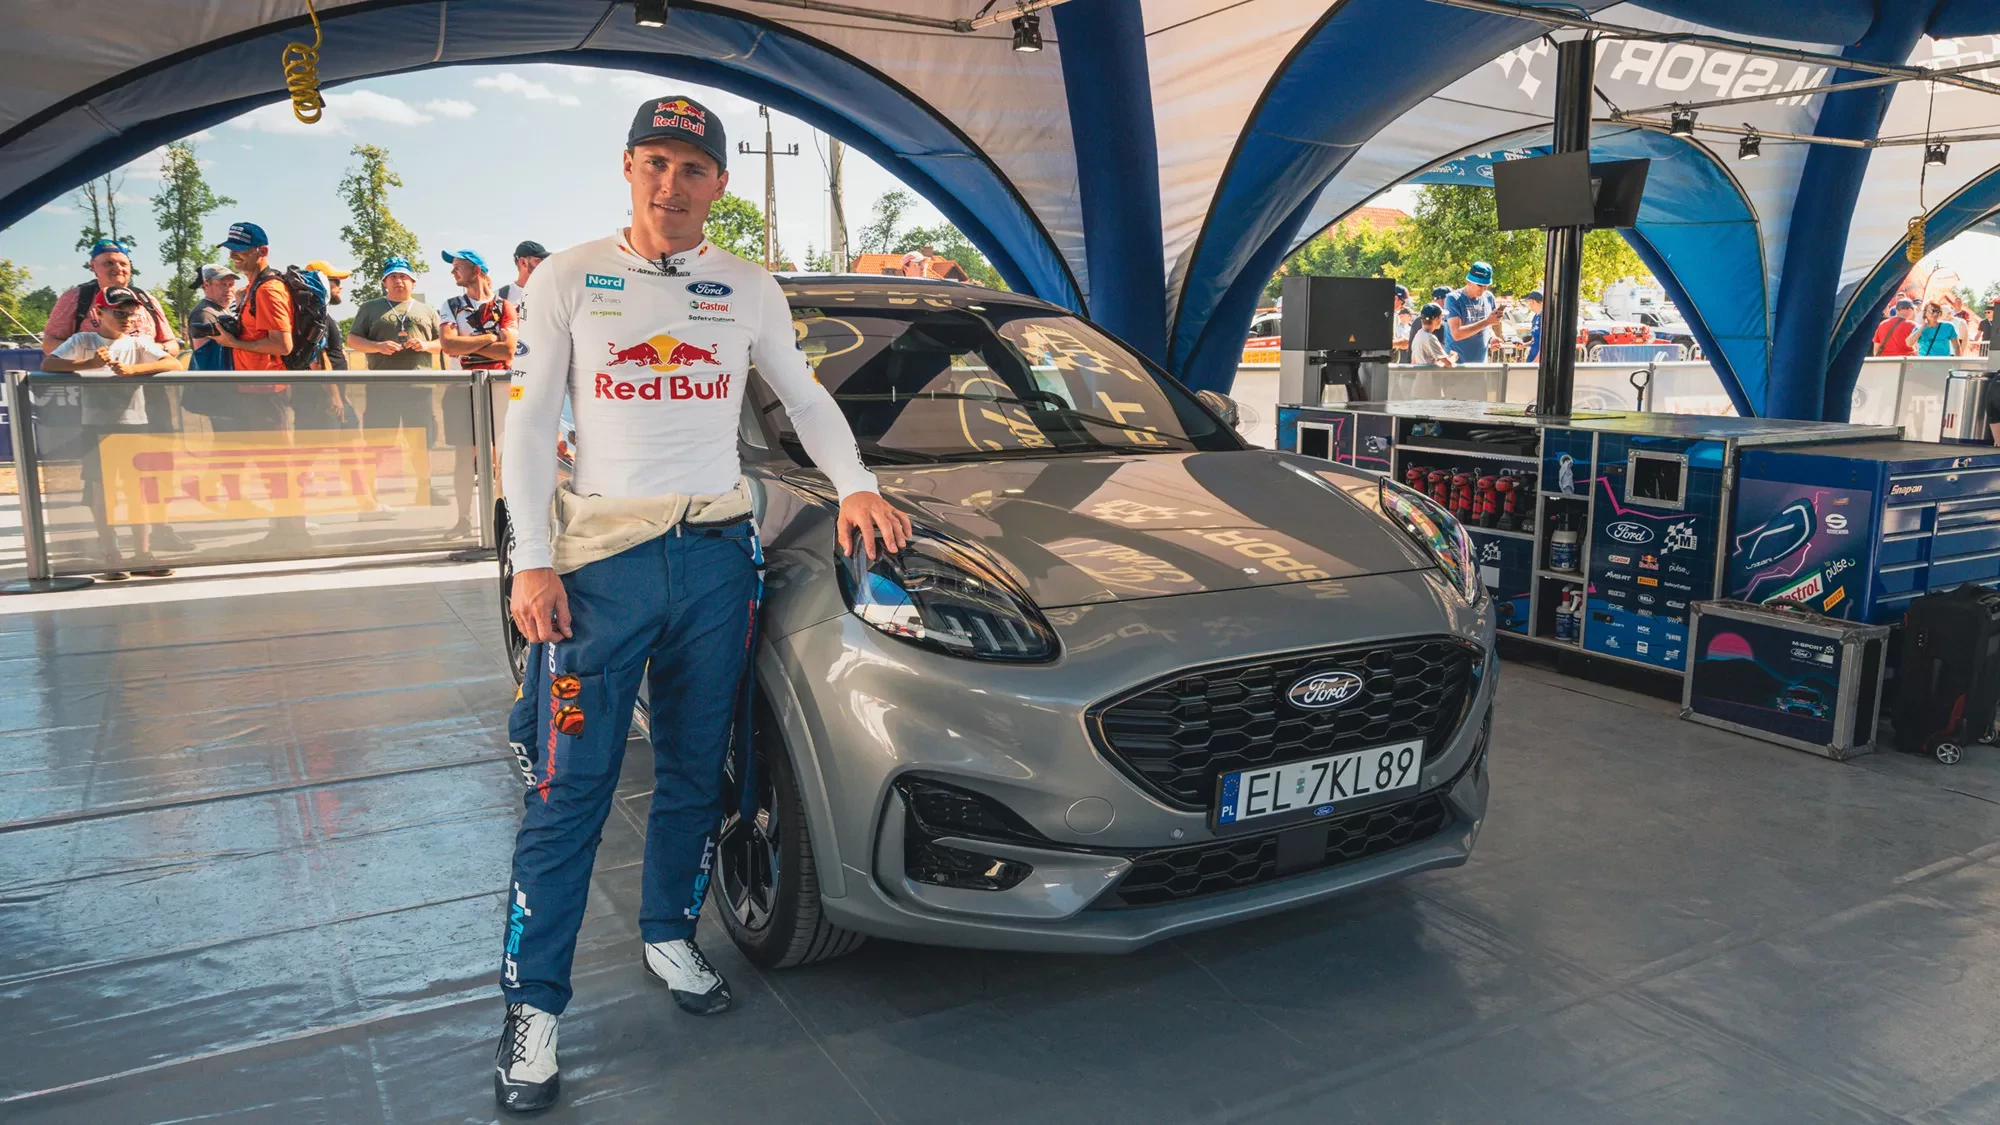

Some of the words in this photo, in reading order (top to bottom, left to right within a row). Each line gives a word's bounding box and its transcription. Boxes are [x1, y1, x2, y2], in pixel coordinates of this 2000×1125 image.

[653, 115, 679, 128] Red
[680, 117, 705, 137] Bull
[588, 275, 622, 288] Nord
[695, 283, 724, 296] Ford
[699, 301, 729, 313] Castrol
[595, 373, 662, 401] Red
[670, 373, 731, 401] Bull
[1890, 484, 1923, 496] Snap-on
[1613, 523, 1646, 542] Ford
[1304, 677, 1349, 704] Ford
[1245, 770, 1291, 817] EL
[1307, 747, 1415, 805] 7KL89
[1221, 805, 1235, 818] PL
